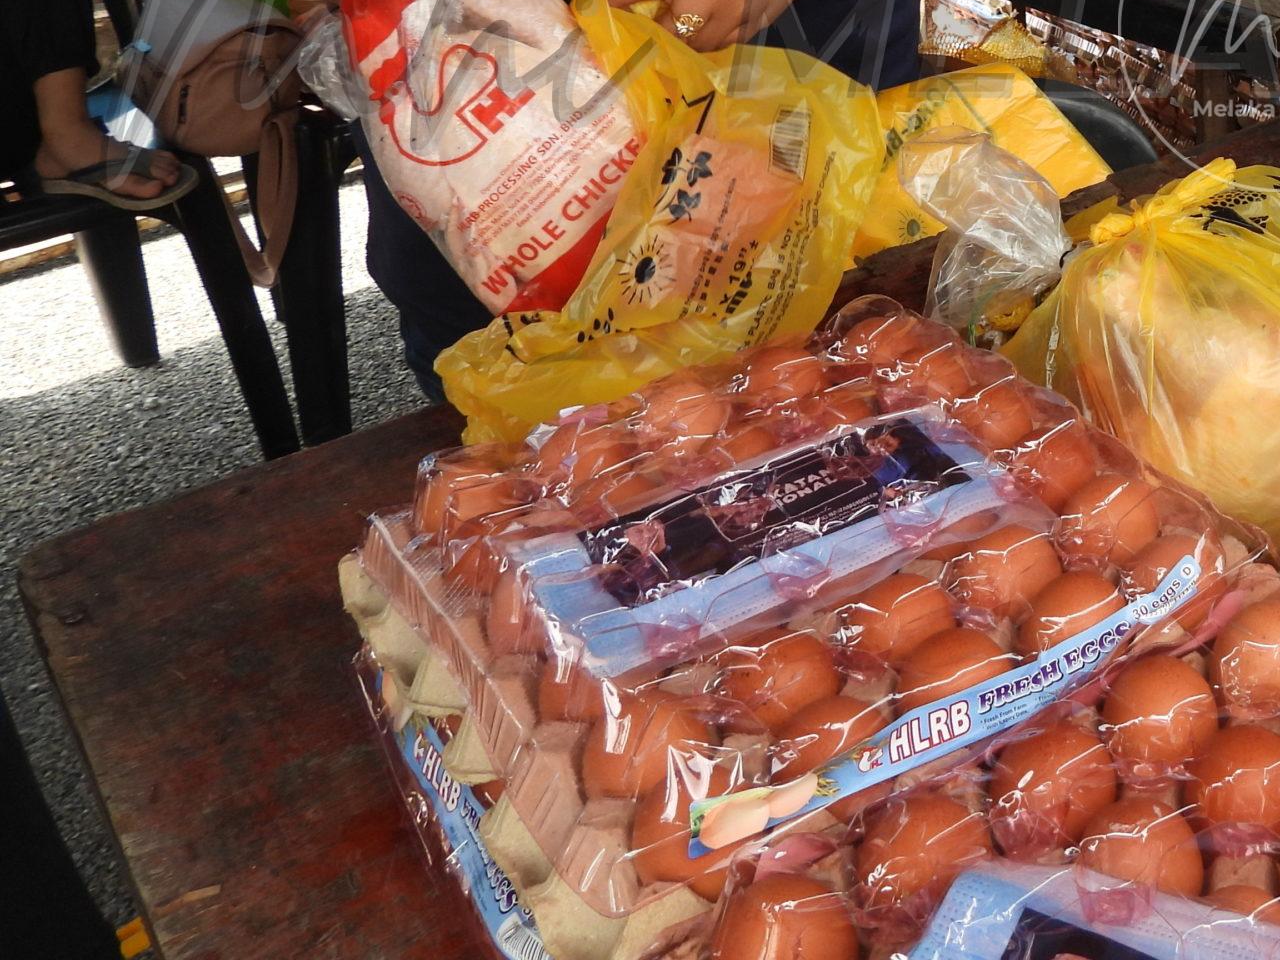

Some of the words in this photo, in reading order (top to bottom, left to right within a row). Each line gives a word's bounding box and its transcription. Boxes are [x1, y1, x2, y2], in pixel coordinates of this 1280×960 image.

[538, 133, 564, 156] SDN.
[482, 218, 566, 296] WHOLE
[1182, 566, 1193, 576] D
[1132, 603, 1149, 621] 30
[1151, 578, 1182, 609] eggs
[889, 700, 972, 763] HLRB
[977, 658, 1064, 714] FRESH
[1062, 621, 1134, 677] EGGS
[421, 745, 461, 813] HLRB
